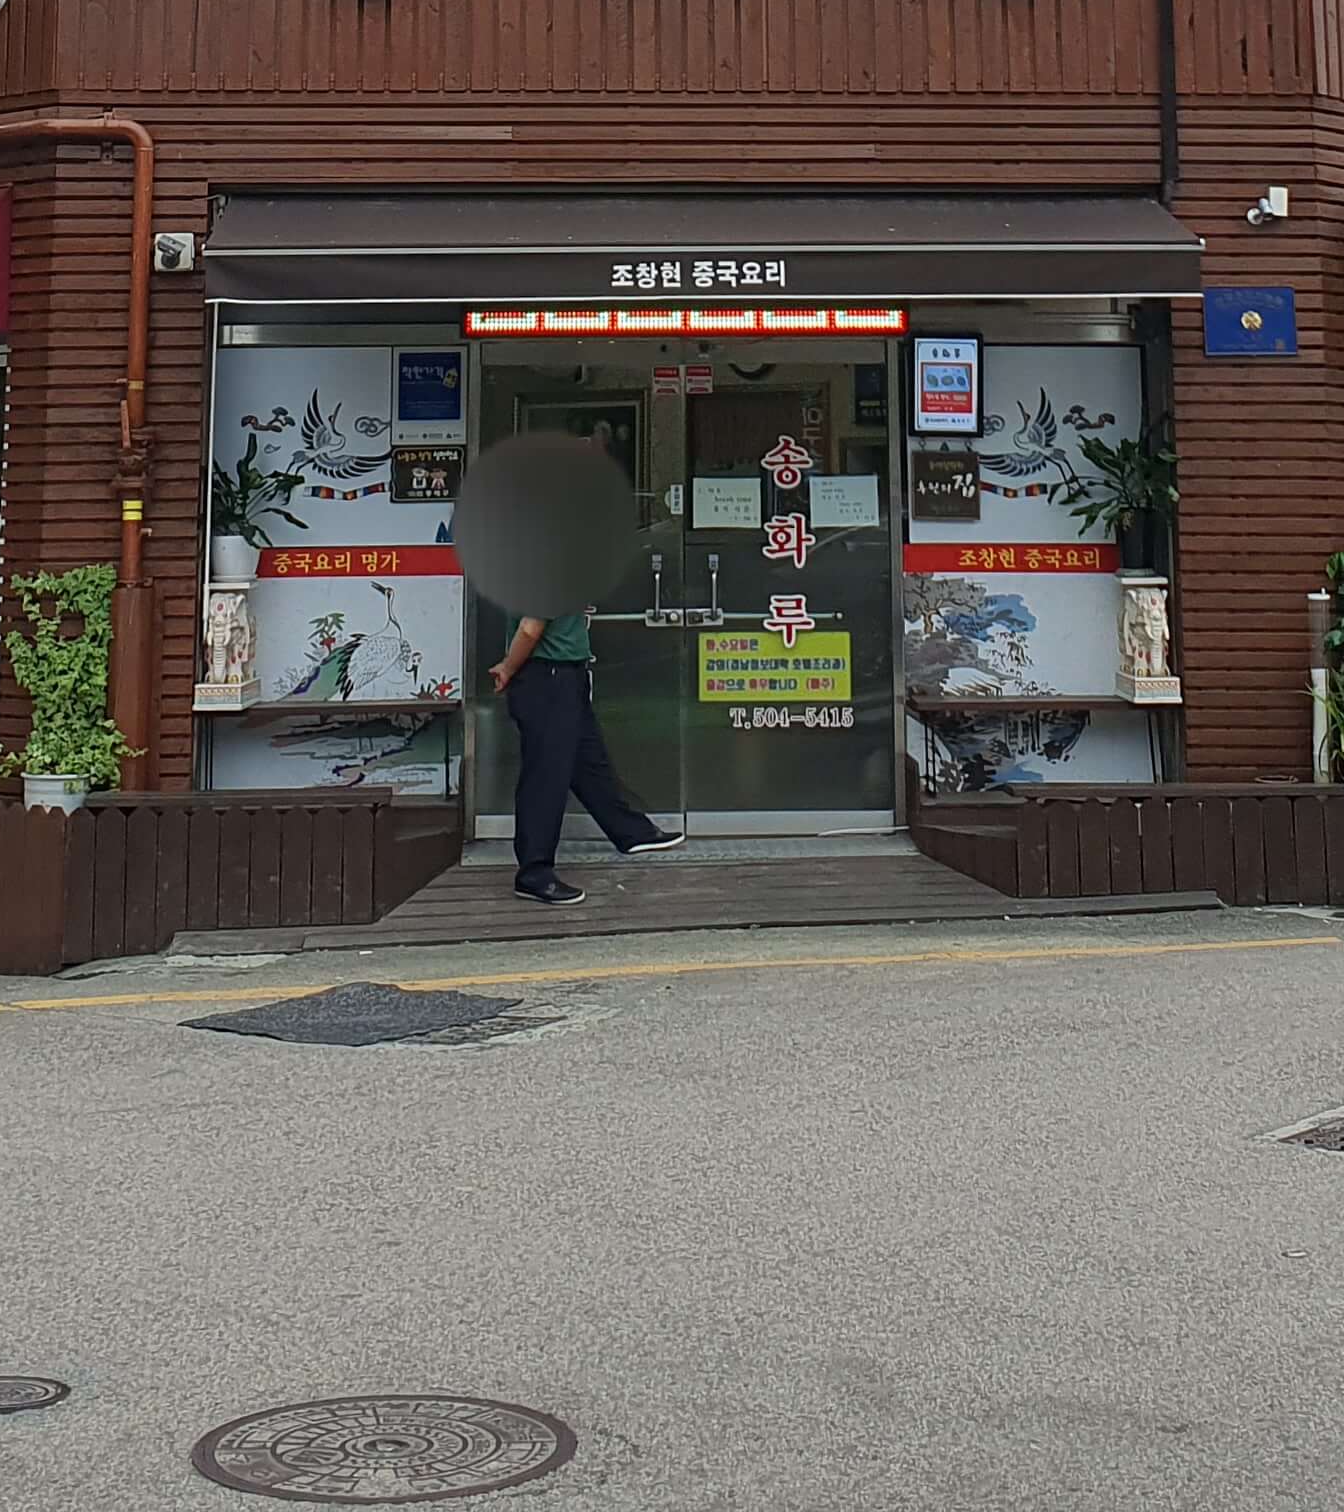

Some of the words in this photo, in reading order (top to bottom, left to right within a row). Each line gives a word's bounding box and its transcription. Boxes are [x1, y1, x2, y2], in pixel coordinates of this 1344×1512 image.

[611, 261, 683, 289] 조창현
[692, 259, 788, 288] 중국요리
[761, 434, 816, 649] 송화루
[271, 552, 352, 574] 중국요리
[361, 551, 401, 574] 명가
[958, 547, 1017, 568] 조창현
[1023, 547, 1101, 569] 중국요리
[728, 706, 855, 730] T.504-5415
